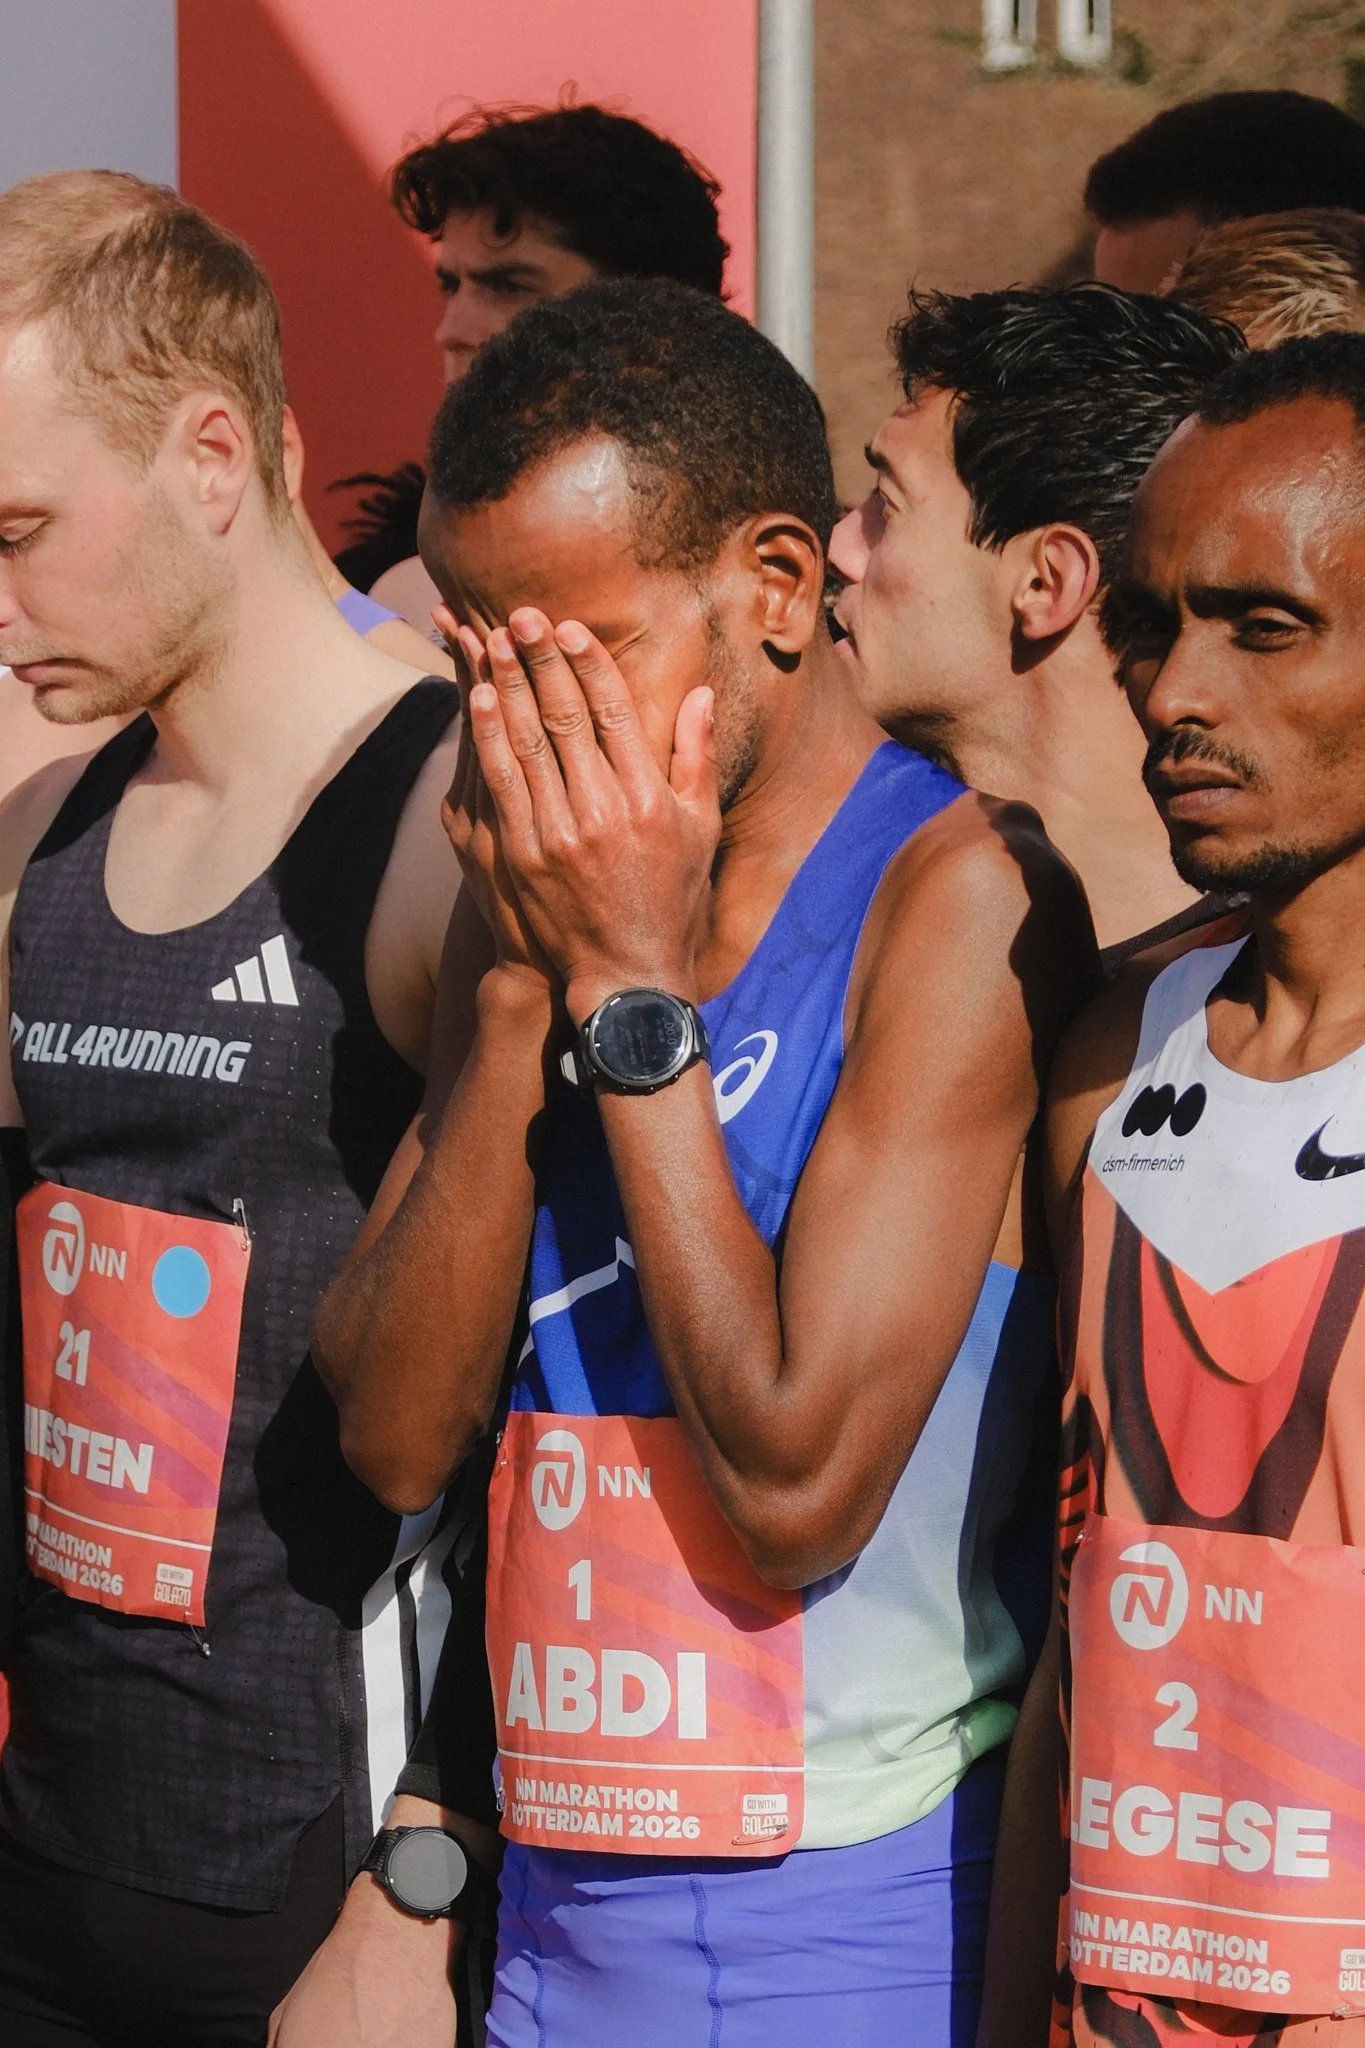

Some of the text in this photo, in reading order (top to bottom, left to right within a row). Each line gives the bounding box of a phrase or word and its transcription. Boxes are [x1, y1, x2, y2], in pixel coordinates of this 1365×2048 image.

[23, 1021, 252, 1083] ALL4RUNNING
[1102, 1153, 1185, 1172] dsm-firmenich
[89, 1243, 127, 1280] NN
[55, 1320, 91, 1387] 21
[597, 1465, 651, 1498] NN
[79, 1565, 124, 1596] 2026
[568, 1559, 592, 1621] 1
[1205, 1584, 1263, 1625] NN
[506, 1642, 707, 1739] ABDI
[1154, 1681, 1199, 1751] 2
[515, 1777, 678, 1812] NN MARATHON
[747, 1799, 777, 1809] GO WITH
[628, 1815, 700, 1839] 2026
[1071, 1777, 1332, 1878] EGESE
[1075, 1909, 1269, 1964] NN MARATHON
[1070, 1934, 1291, 1995] OTTERDAM 2026
[1339, 1970, 1365, 1991] GOL
